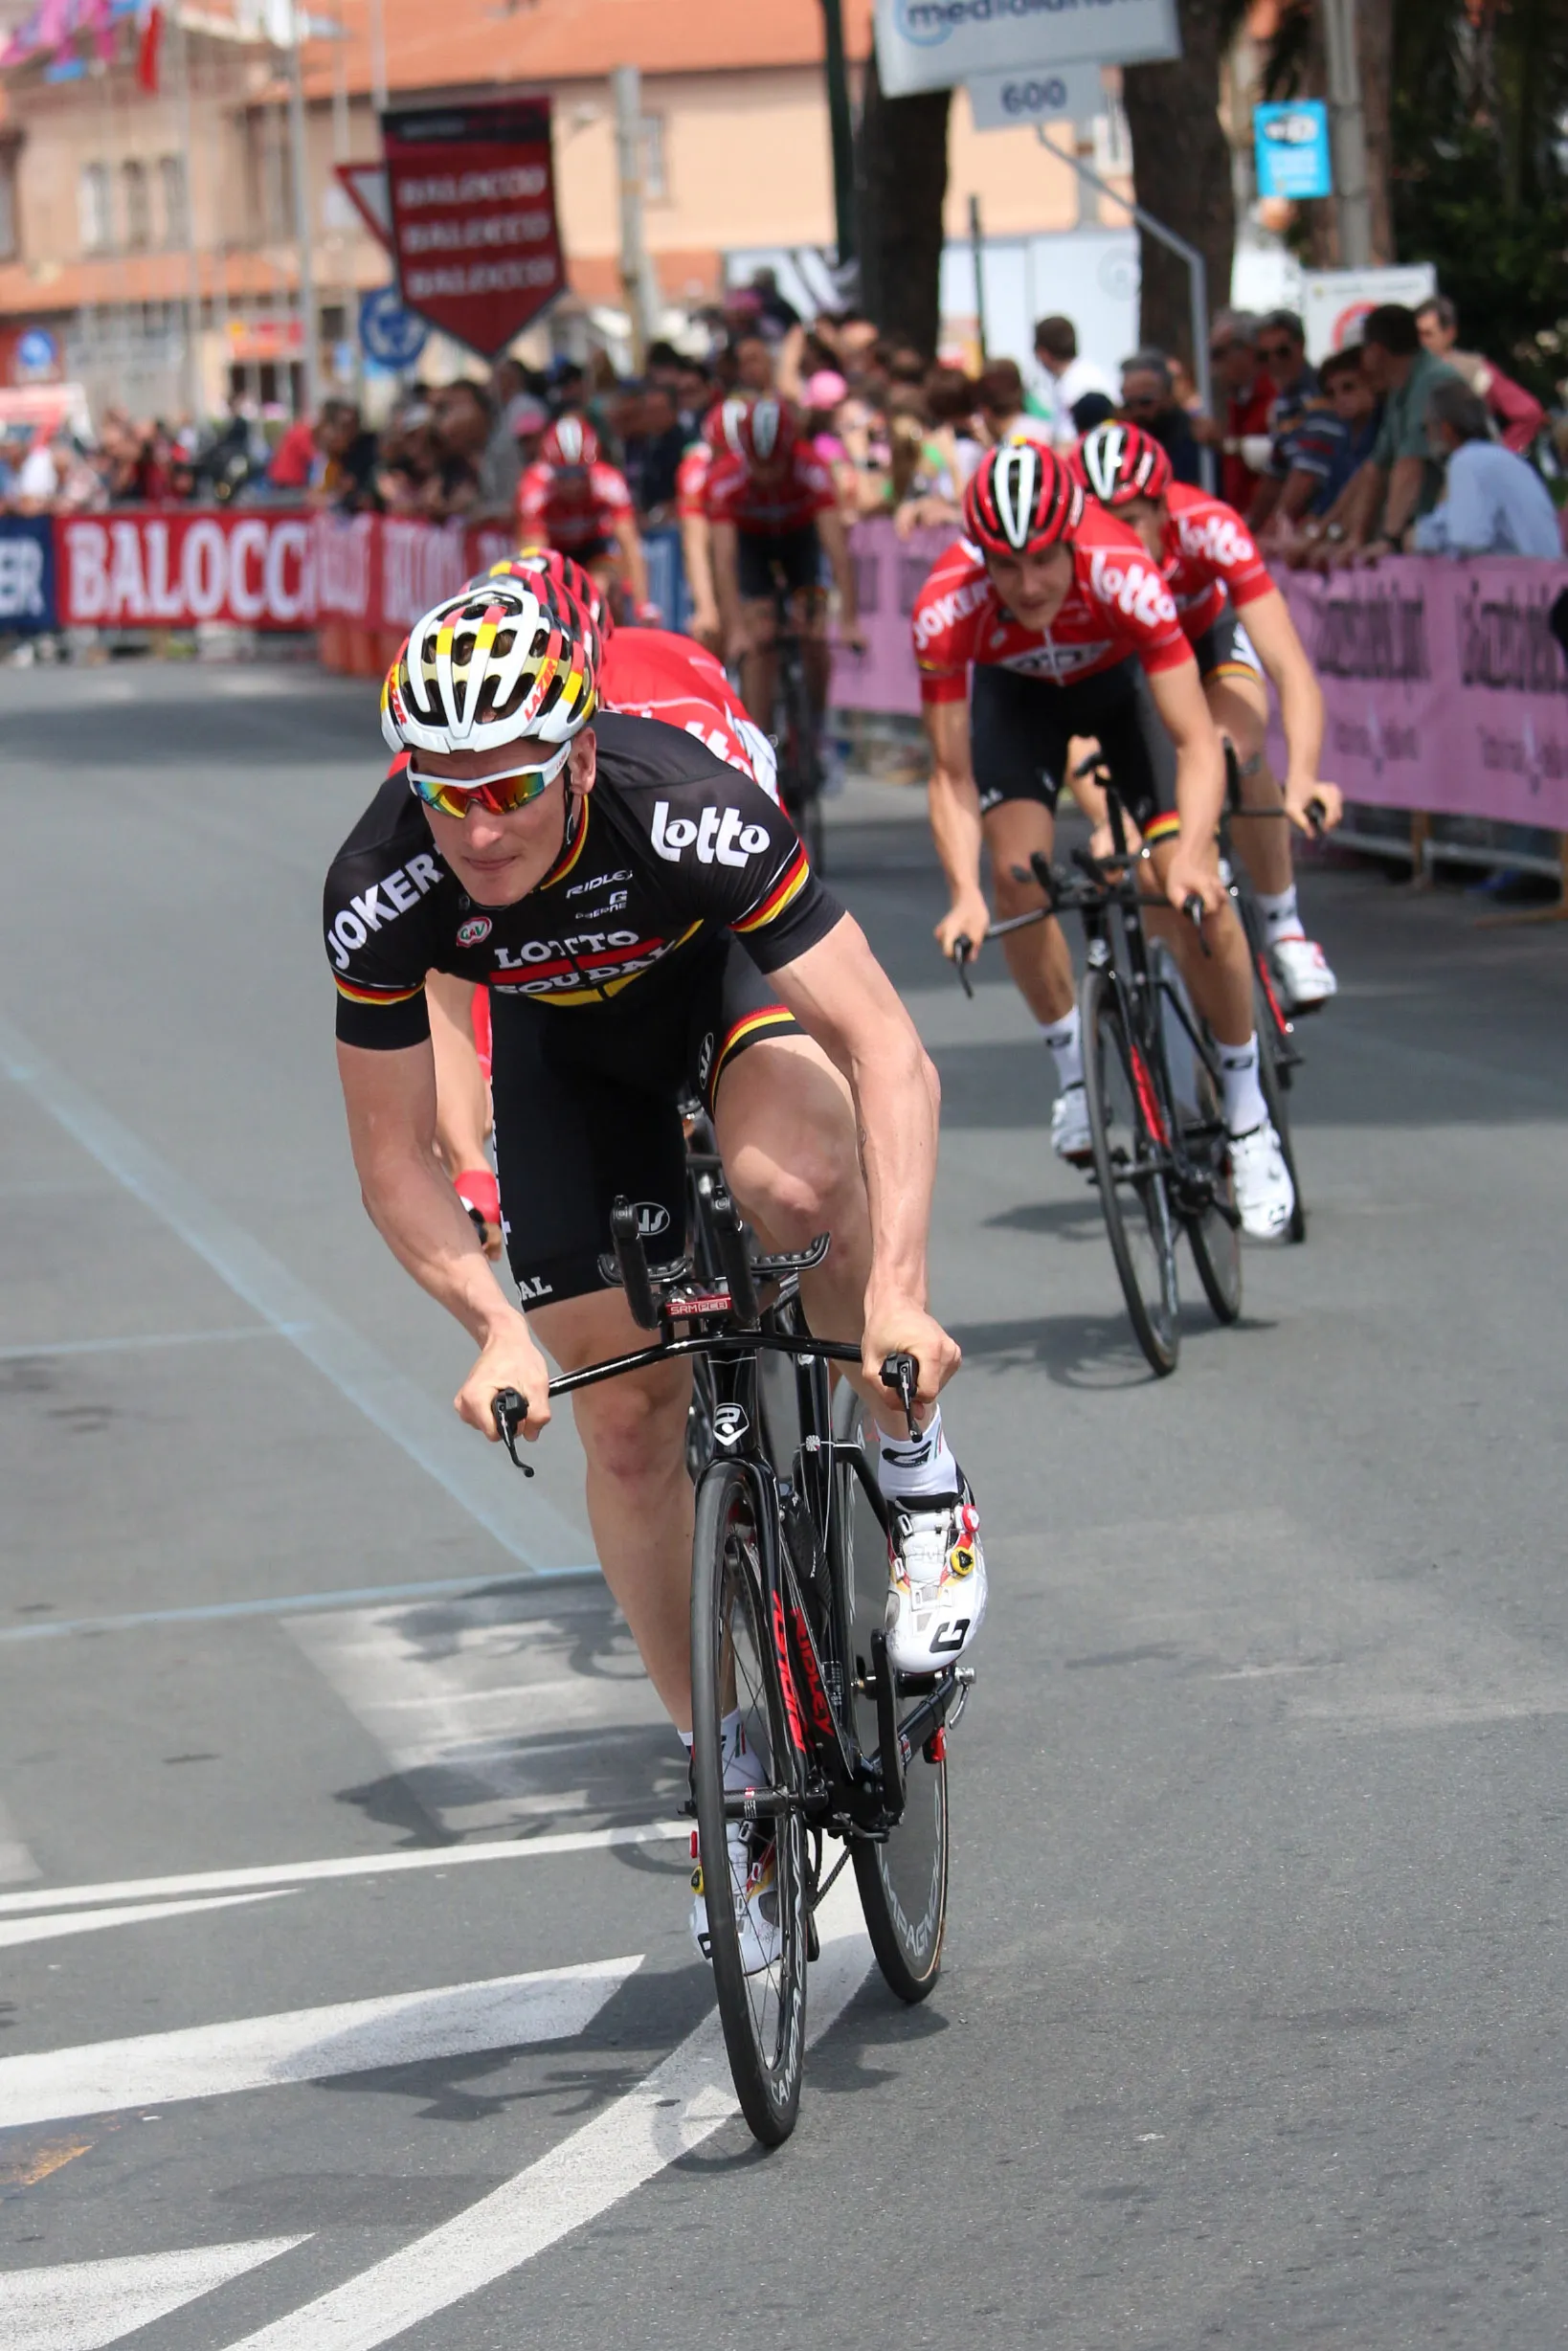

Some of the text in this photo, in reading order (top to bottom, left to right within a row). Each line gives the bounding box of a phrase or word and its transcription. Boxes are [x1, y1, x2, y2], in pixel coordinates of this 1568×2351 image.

[999, 77, 1066, 115] 600
[1090, 549, 1178, 628] lotto
[524, 657, 558, 722] LAZER
[650, 800, 771, 868] lotto
[327, 853, 445, 971] JOKER
[566, 869, 634, 899] RIDLEY
[494, 930, 639, 970] LOTTO
[495, 939, 676, 995] SOUDAL
[670, 1303, 697, 1315] SRM
